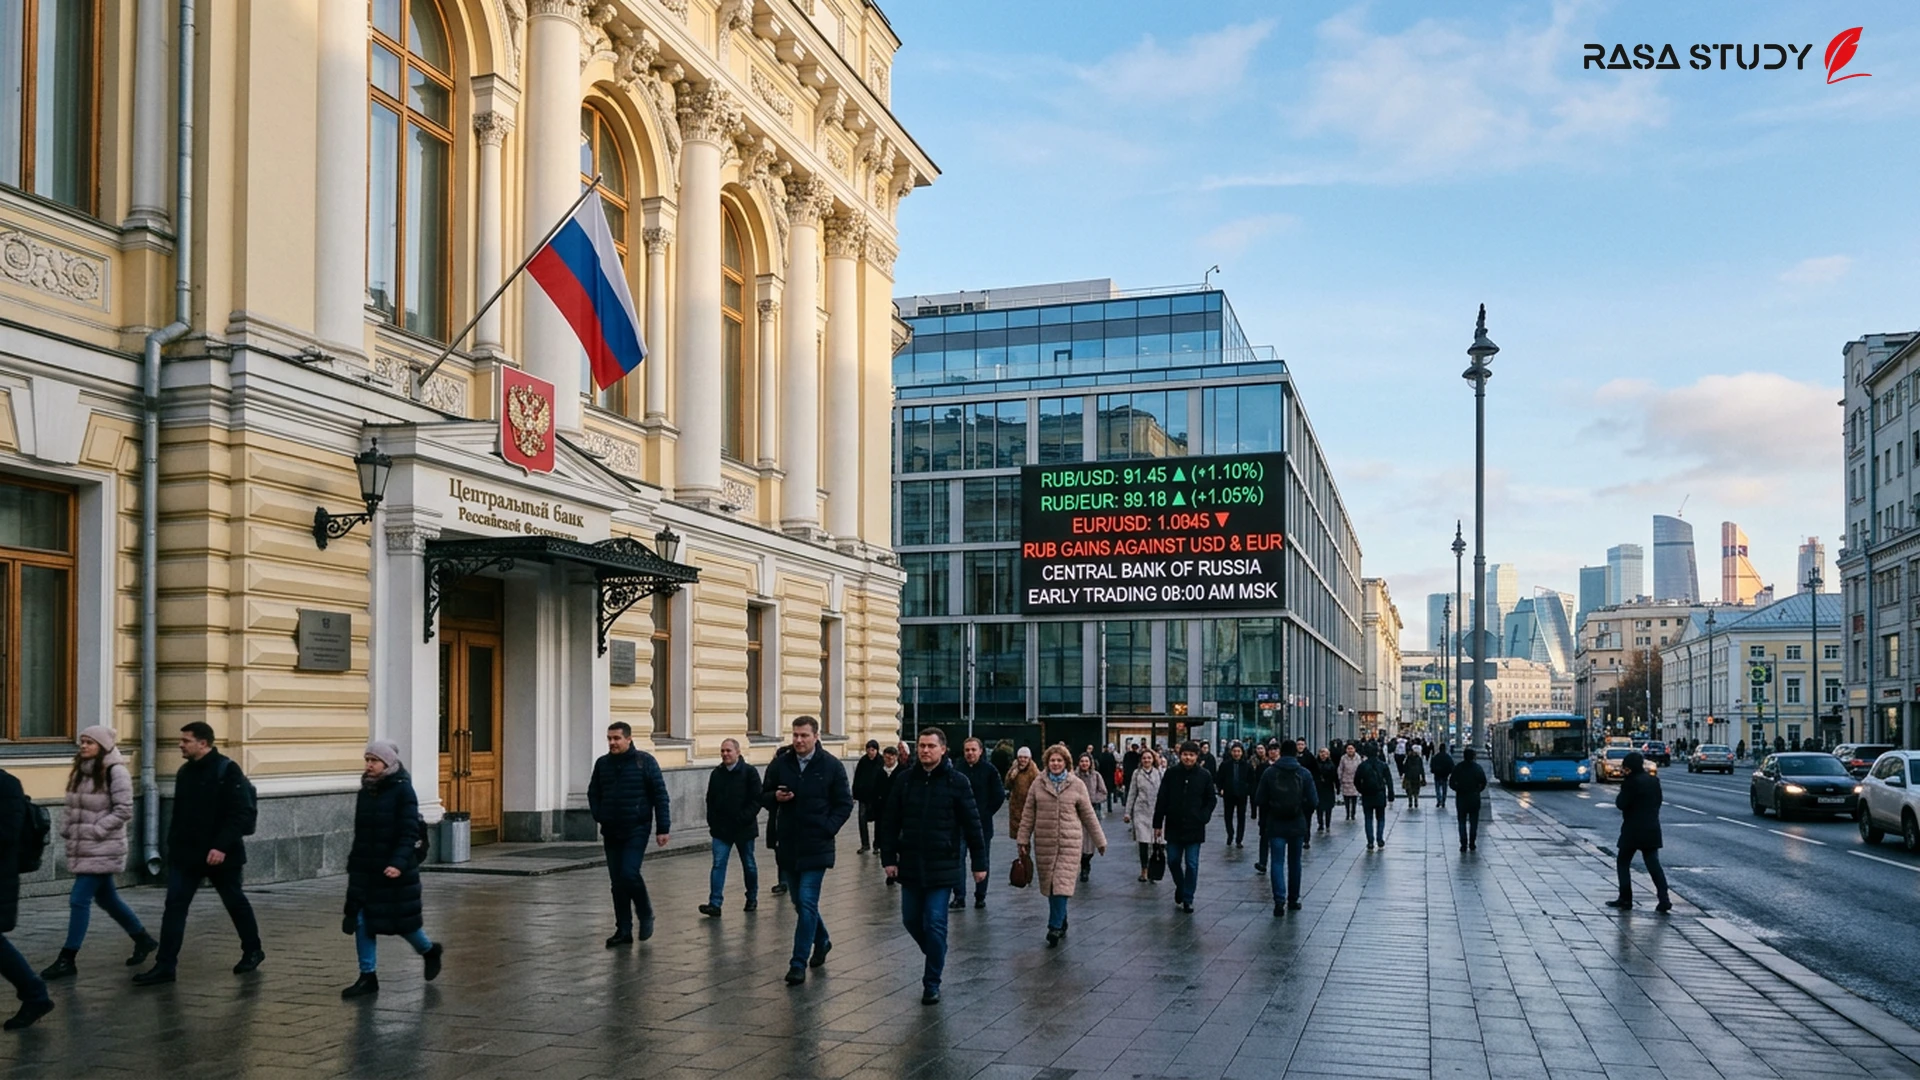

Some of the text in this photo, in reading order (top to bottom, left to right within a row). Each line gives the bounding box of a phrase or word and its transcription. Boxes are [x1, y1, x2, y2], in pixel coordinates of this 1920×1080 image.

[1041, 461, 1264, 488] RUB/USD: 91.45 (+1.10%)
[1041, 493, 1119, 512] RUB/EUR:
[1191, 486, 1264, 508] (+1.05%)
[1072, 515, 1152, 534] EUR/USD:
[1023, 533, 1283, 559] RUB GAINS AGAINST USD & EUR
[1042, 559, 1263, 582] CENTRAL BANK OF RUSSIA
[1028, 588, 1080, 605] EARLY
[1082, 586, 1158, 604] TRADING
[1207, 583, 1235, 601] AM
[1238, 582, 1279, 600] MSK
